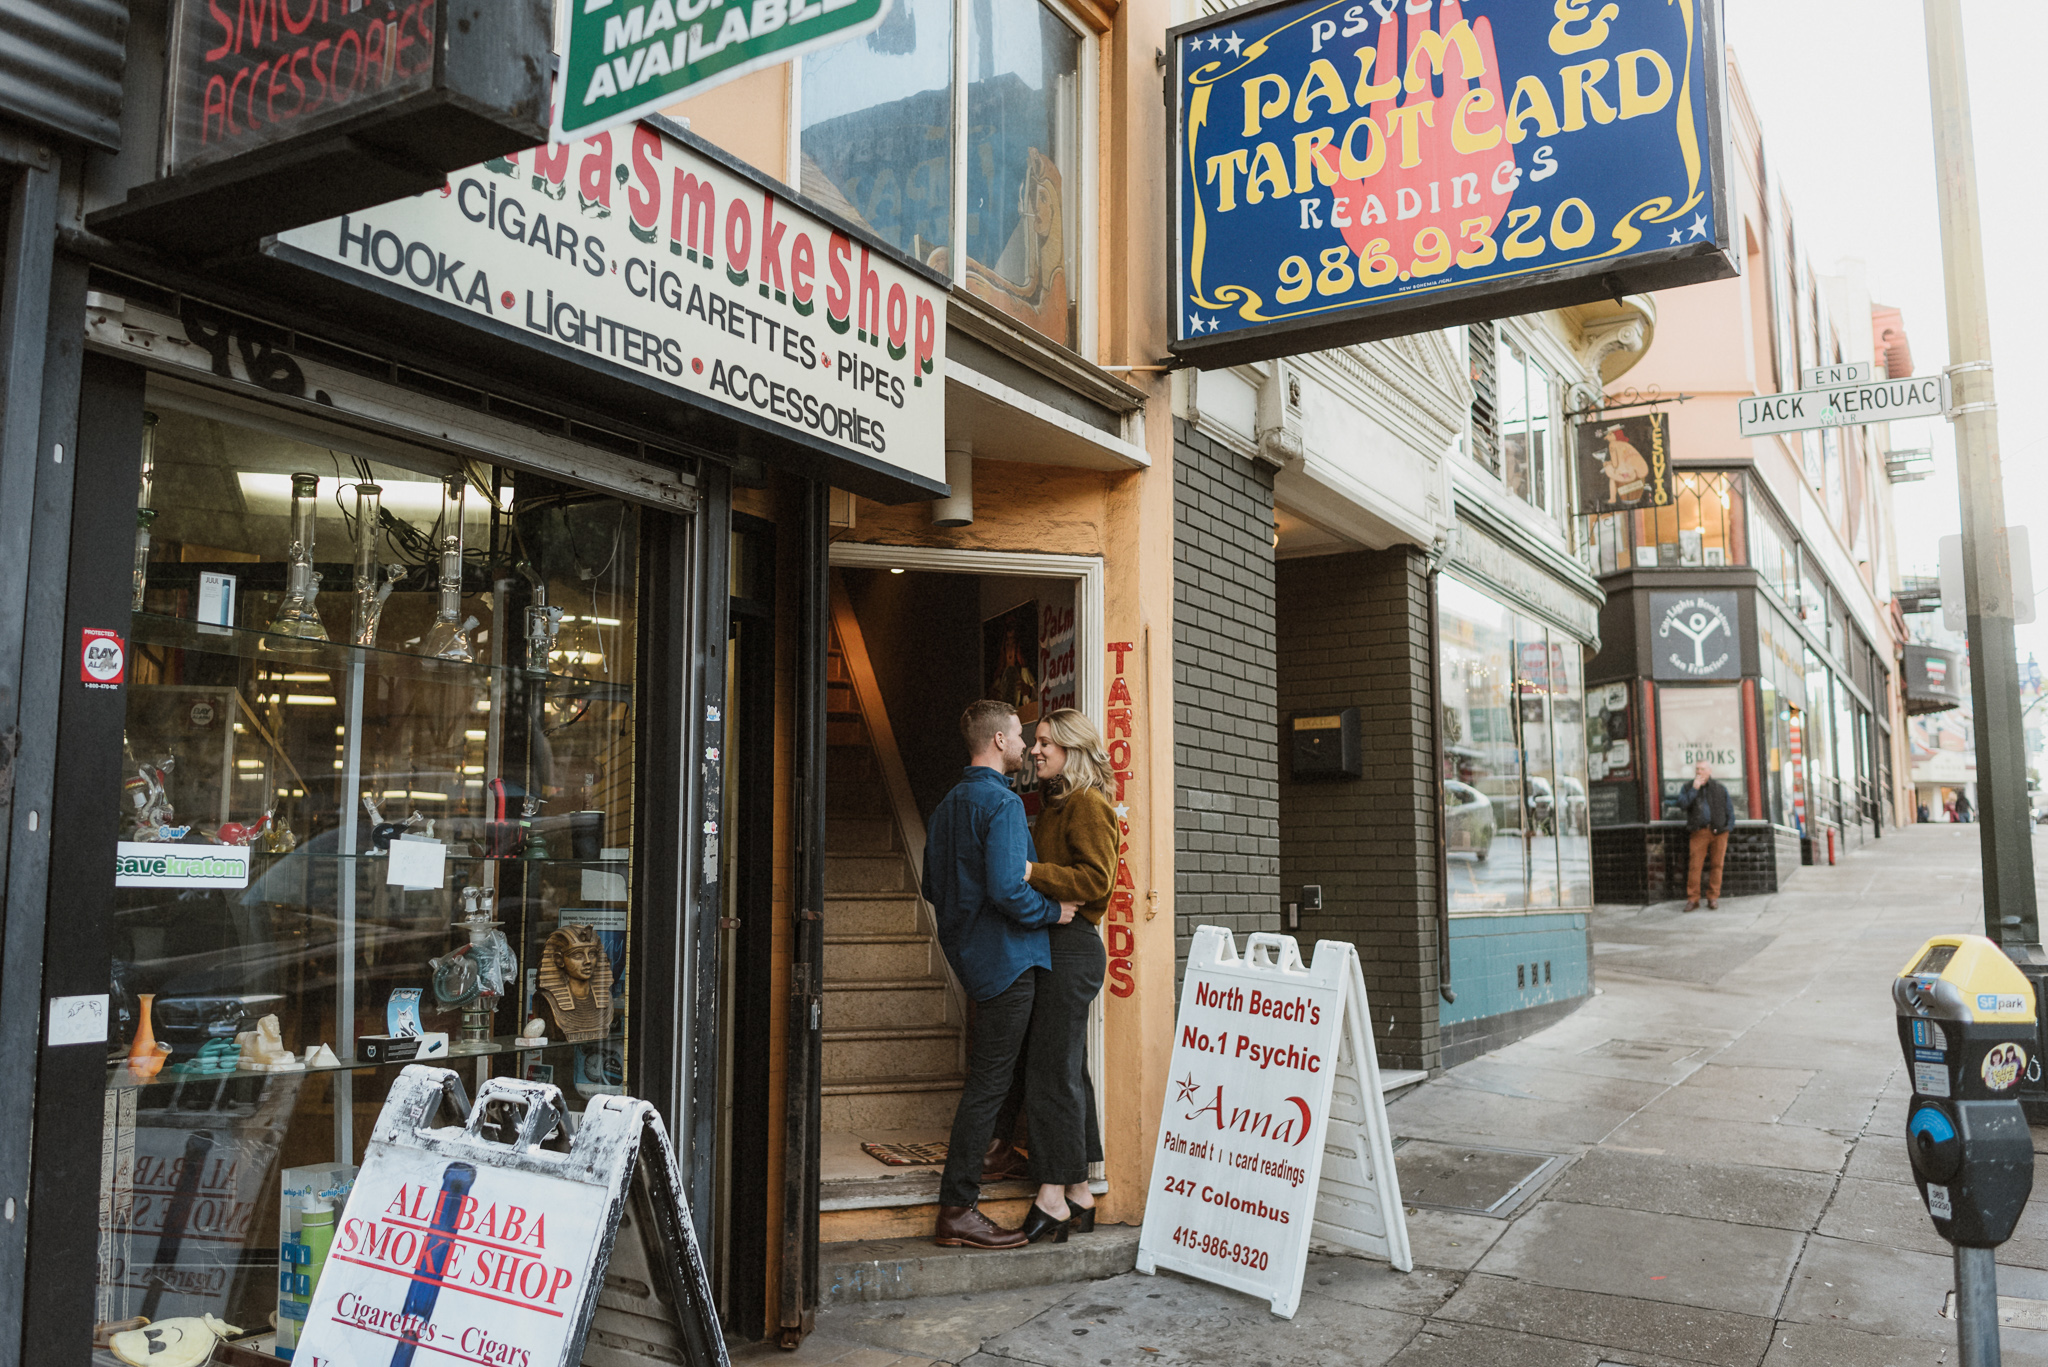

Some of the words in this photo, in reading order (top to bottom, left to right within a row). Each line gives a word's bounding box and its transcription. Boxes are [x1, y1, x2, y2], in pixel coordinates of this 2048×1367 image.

[1241, 19, 1487, 138] PALM
[1547, 0, 1619, 55] &
[1206, 100, 1435, 213] TAROT
[1450, 48, 1674, 156] CARD
[1299, 145, 1559, 231] READINGS
[338, 214, 494, 316] HOOKA
[1275, 197, 1596, 305] 986.9320
[1412, 280, 1438, 290] BOHEMIA
[1747, 397, 1805, 424] JACK
[1828, 381, 1936, 414] KEROUAC
[1815, 366, 1858, 385] END
[1649, 413, 1668, 506] VESUVIO
[84, 629, 115, 637] PROTECTED
[1659, 615, 1673, 637] City
[1666, 598, 1695, 619] Lights
[1696, 597, 1731, 637] Bookstore
[1668, 653, 1687, 671] San
[1687, 653, 1729, 676] Francisco
[1107, 641, 1134, 802] TAROT
[1685, 749, 1736, 765] BOOKS
[1195, 981, 1243, 1012] North
[1248, 989, 1321, 1026] Beach's
[1182, 1025, 1227, 1055] No.1
[1235, 1034, 1321, 1073] Psychic
[1185, 1085, 1297, 1143] Anna
[1163, 1130, 1187, 1155] Palm
[1189, 1140, 1208, 1159] and
[1235, 1152, 1260, 1173] card
[1260, 1158, 1305, 1188] readings
[386, 1182, 451, 1225] ALI
[452, 1195, 547, 1250] BABA
[1164, 1175, 1197, 1199] 247
[1201, 1186, 1291, 1225] Colombus
[336, 1217, 467, 1280] SMOKE
[470, 1249, 573, 1305] SHOP
[1172, 1225, 1269, 1272] 415-986-9320
[336, 1291, 438, 1343] Cigarettes
[460, 1325, 532, 1367] Cigars
